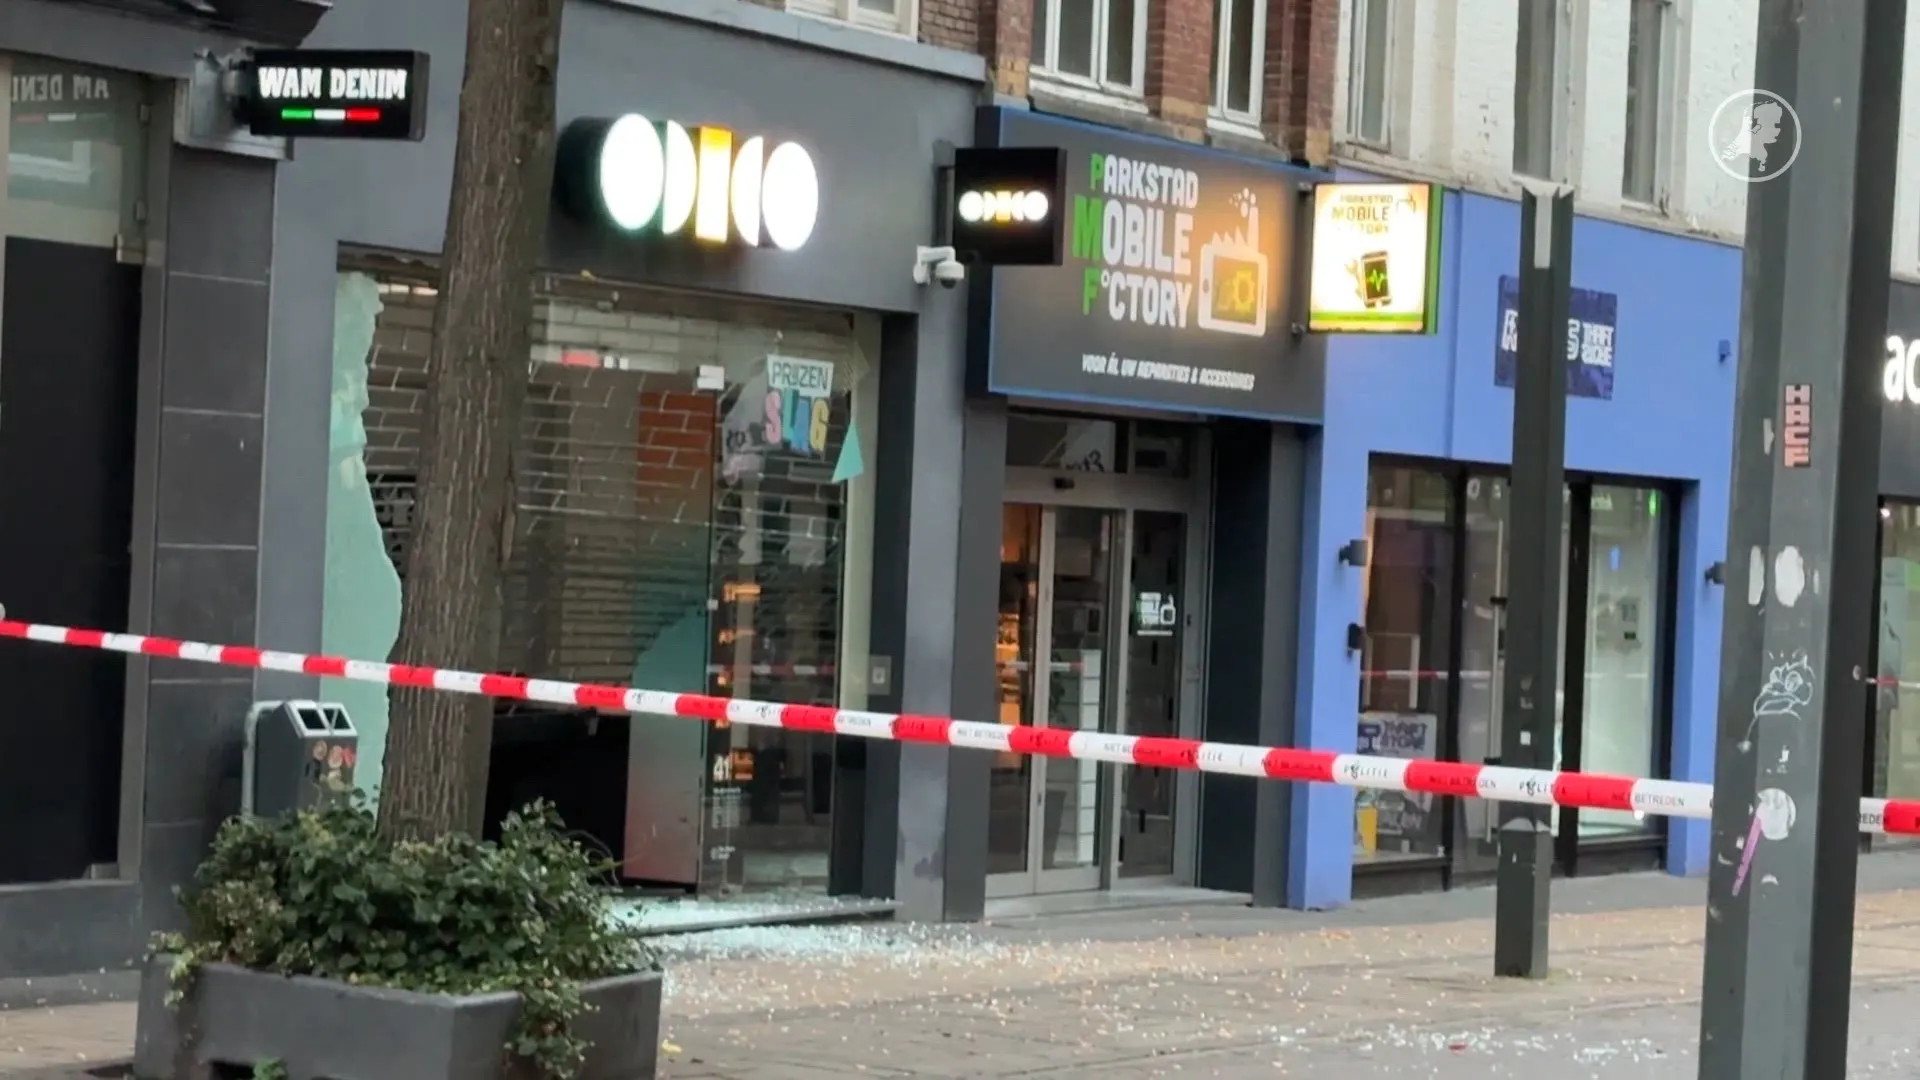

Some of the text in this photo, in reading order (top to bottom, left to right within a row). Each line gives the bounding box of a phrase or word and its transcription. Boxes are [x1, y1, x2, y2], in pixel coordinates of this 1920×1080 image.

[258, 66, 407, 100] WAM DENIM
[1090, 153, 1199, 209] PARKSTAD
[1332, 205, 1390, 221] MOBILE
[1072, 194, 1194, 276] MOBILE
[1635, 794, 1684, 806] BETREDEN
